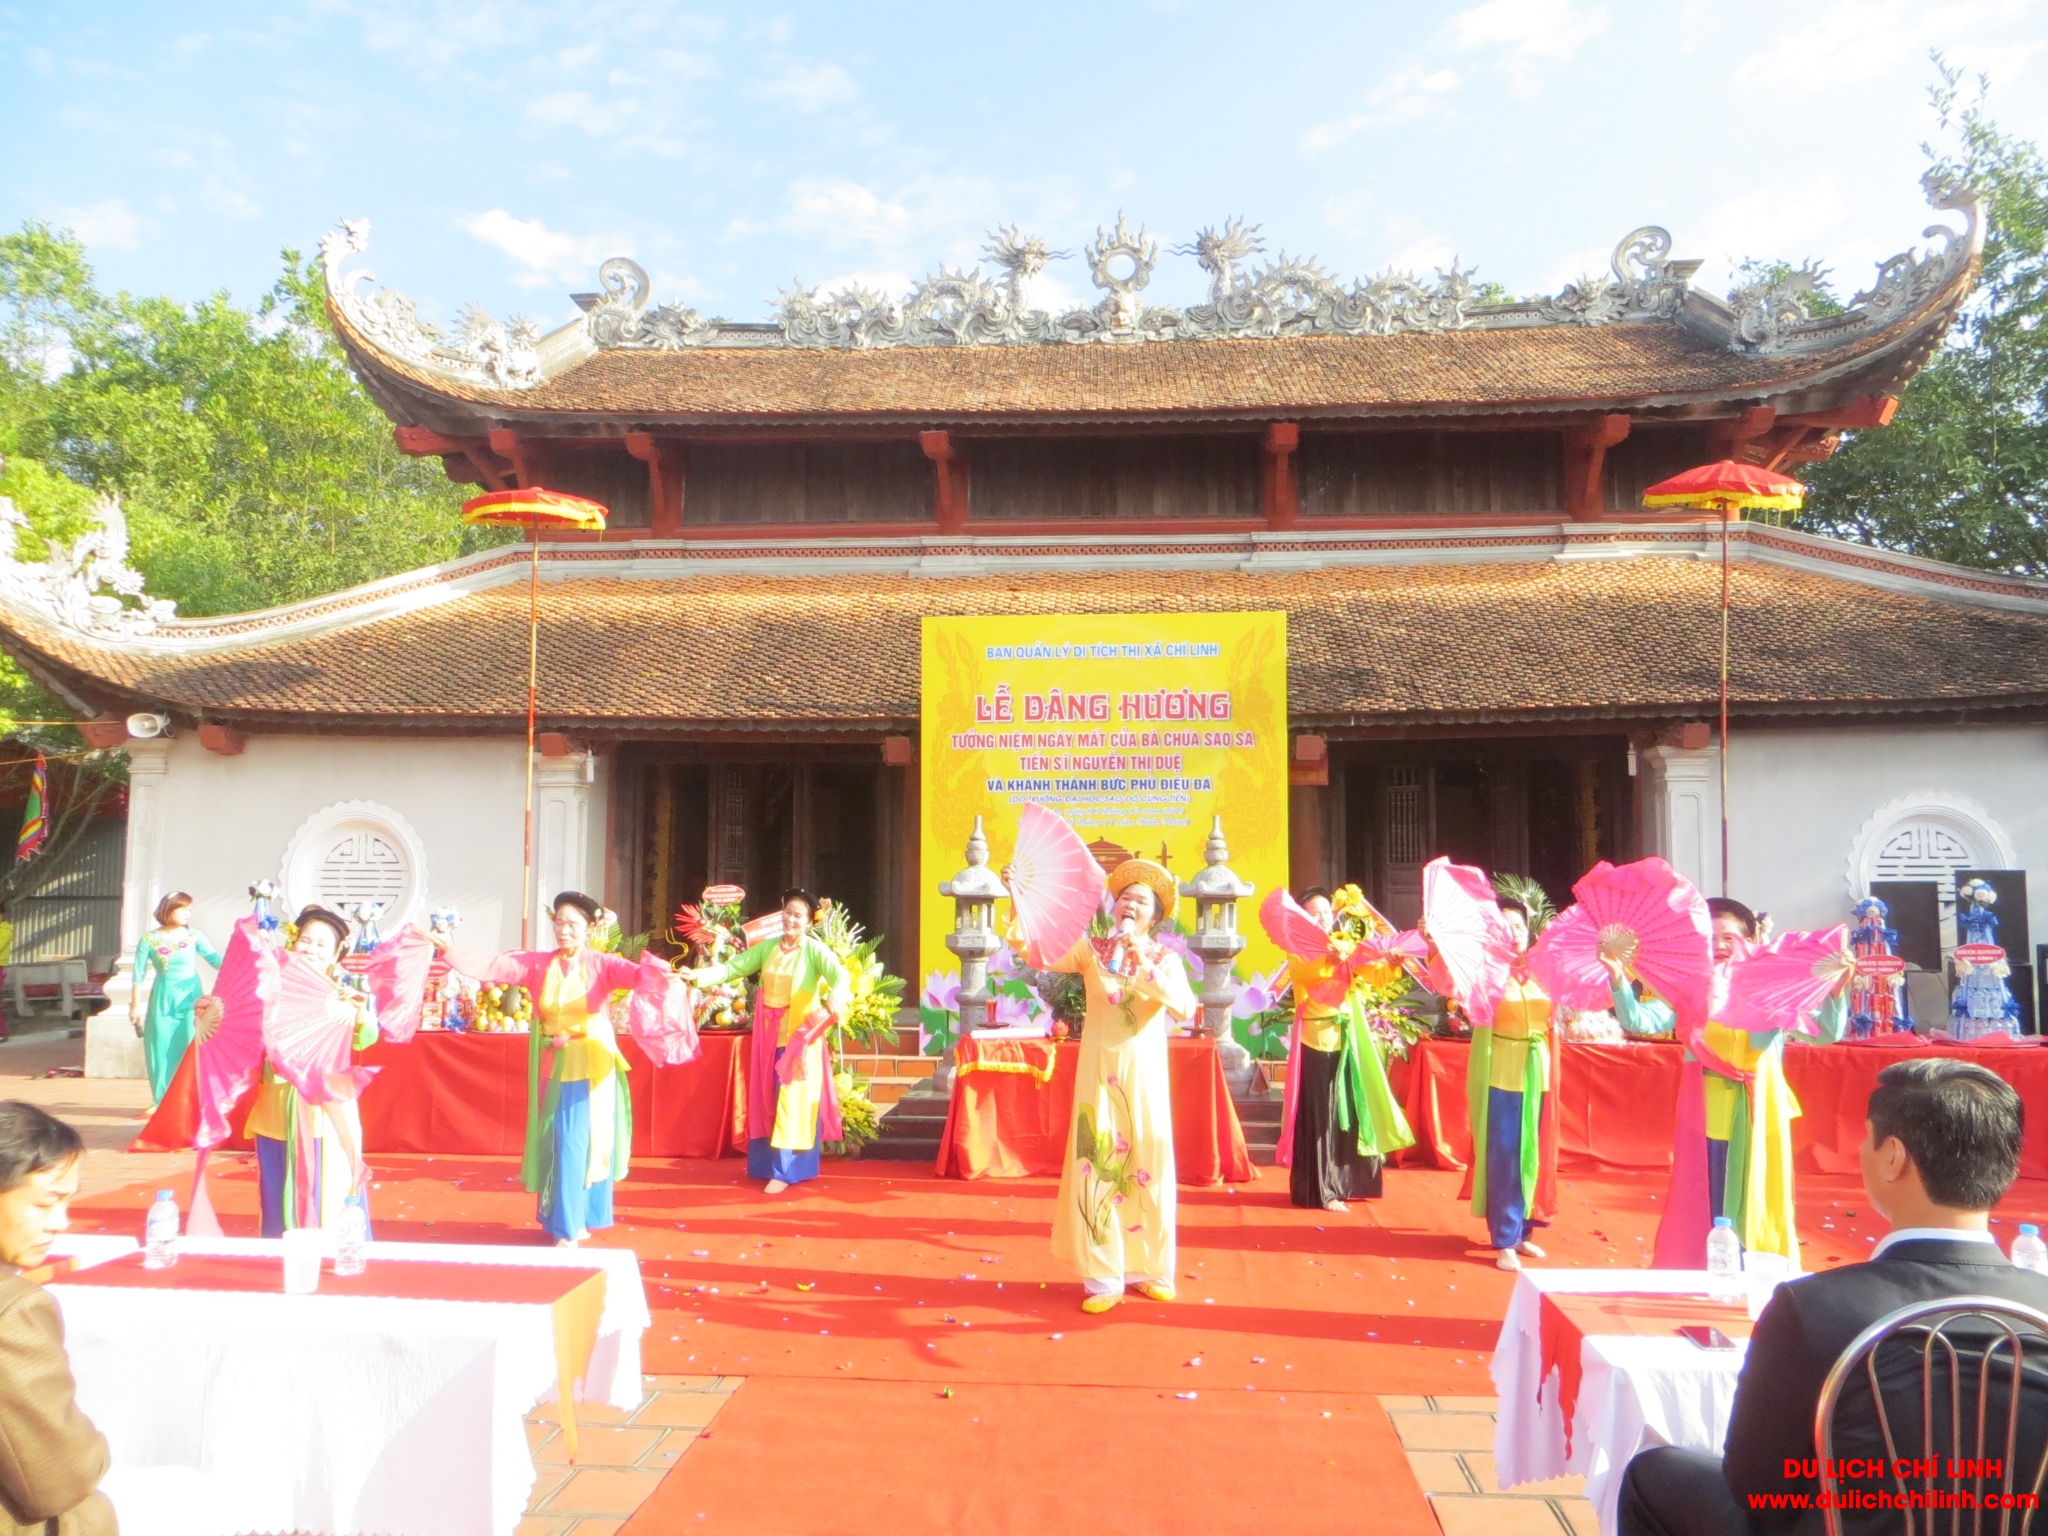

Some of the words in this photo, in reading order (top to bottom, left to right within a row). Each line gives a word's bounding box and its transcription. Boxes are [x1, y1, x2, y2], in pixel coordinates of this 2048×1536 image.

[987, 646, 1012, 659] BAN
[1016, 642, 1051, 658] QUẢN
[1055, 643, 1070, 657] LÝ
[1073, 645, 1086, 657] DI
[1090, 641, 1117, 657] TÍCH
[1121, 644, 1141, 660] THỊ
[1144, 641, 1162, 657] XÃ
[1166, 641, 1186, 656] CHÍ
[1190, 644, 1218, 656] LINH
[975, 683, 1012, 722] LỄ
[1024, 689, 1109, 721] DÂNG
[1118, 688, 1230, 721] HƯƠNG
[951, 729, 995, 749] TƯỞNG
[999, 731, 1033, 752] NIỆM
[1038, 730, 1073, 748] NGÀY
[1077, 729, 1106, 747] MẤT
[1110, 727, 1138, 747] CỦA
[1141, 730, 1159, 747] BÀ
[1163, 729, 1200, 747] CHÚA
[1204, 732, 1232, 747] SAO
[1235, 732, 1254, 746] SA
[1019, 751, 1049, 771] TIẾN
[1053, 753, 1068, 771] SĨ
[1072, 751, 1126, 771] NGUYỄN
[1130, 756, 1152, 773] THỊ
[1155, 752, 1182, 773] DUỆ
[987, 777, 1003, 791] VÀ
[1007, 776, 1051, 791] KHÁNH
[1055, 776, 1097, 791] THÀNH
[1100, 775, 1126, 791] BỨC
[1130, 775, 1156, 790] PHÙ
[1193, 774, 1212, 790] ĐÁ
